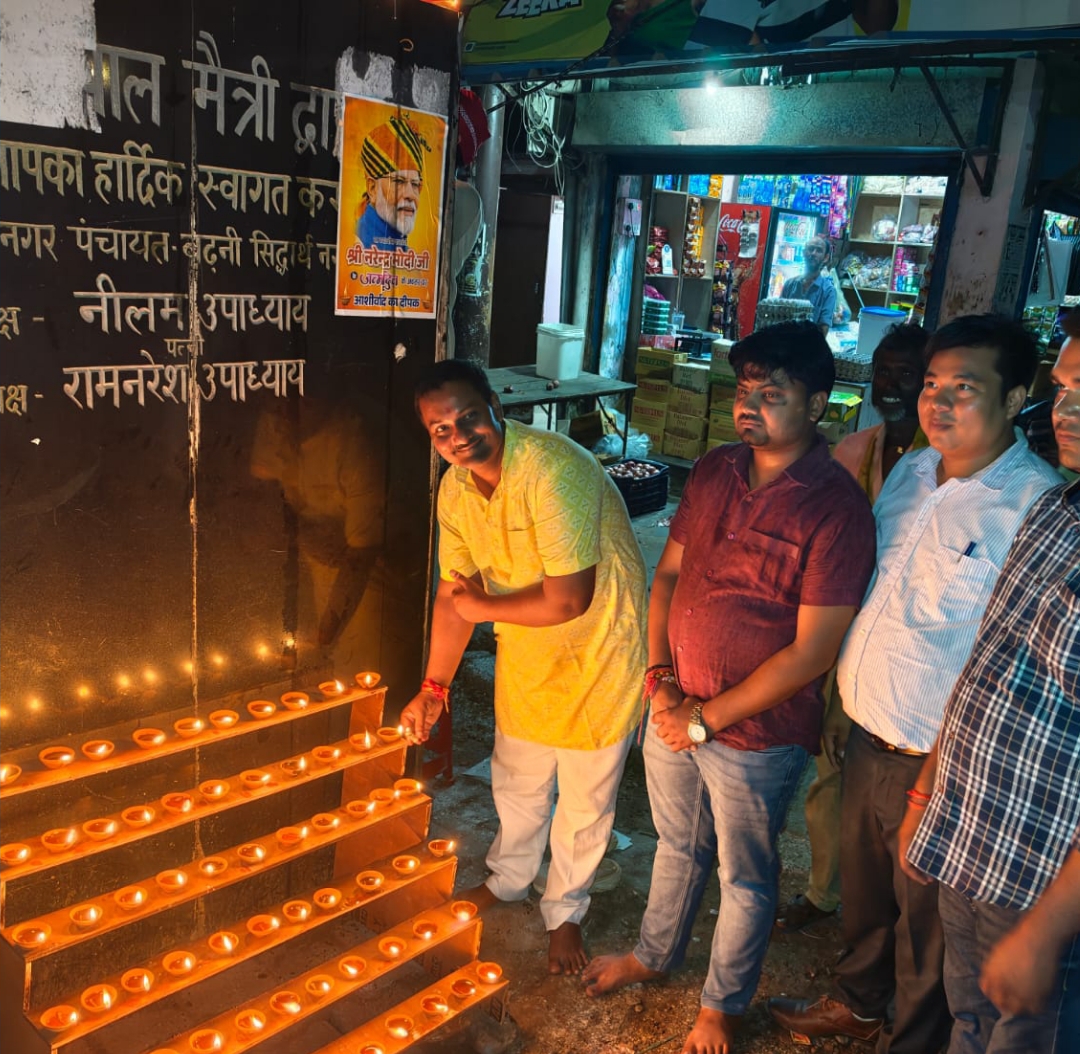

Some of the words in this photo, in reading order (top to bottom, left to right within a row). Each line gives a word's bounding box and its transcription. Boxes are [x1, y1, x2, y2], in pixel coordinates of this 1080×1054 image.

[182, 30, 280, 142] मैत्री
[89, 140, 186, 208] हार्दिक
[196, 164, 292, 216] स्वागत
[0, 220, 58, 262] नगर
[347, 244, 362, 264] श्री
[364, 245, 391, 268] नरेन्द्र
[392, 247, 414, 269] मोदी
[416, 250, 429, 269] जी
[73, 273, 188, 335] नीलम
[198, 293, 312, 333] उपाध्याय
[354, 293, 386, 307] आशीर्वाद
[387, 296, 398, 306] का
[400, 295, 420, 307] दीपक
[62, 349, 190, 409] रामनरेश
[198, 359, 306, 403] उपाध्याय
